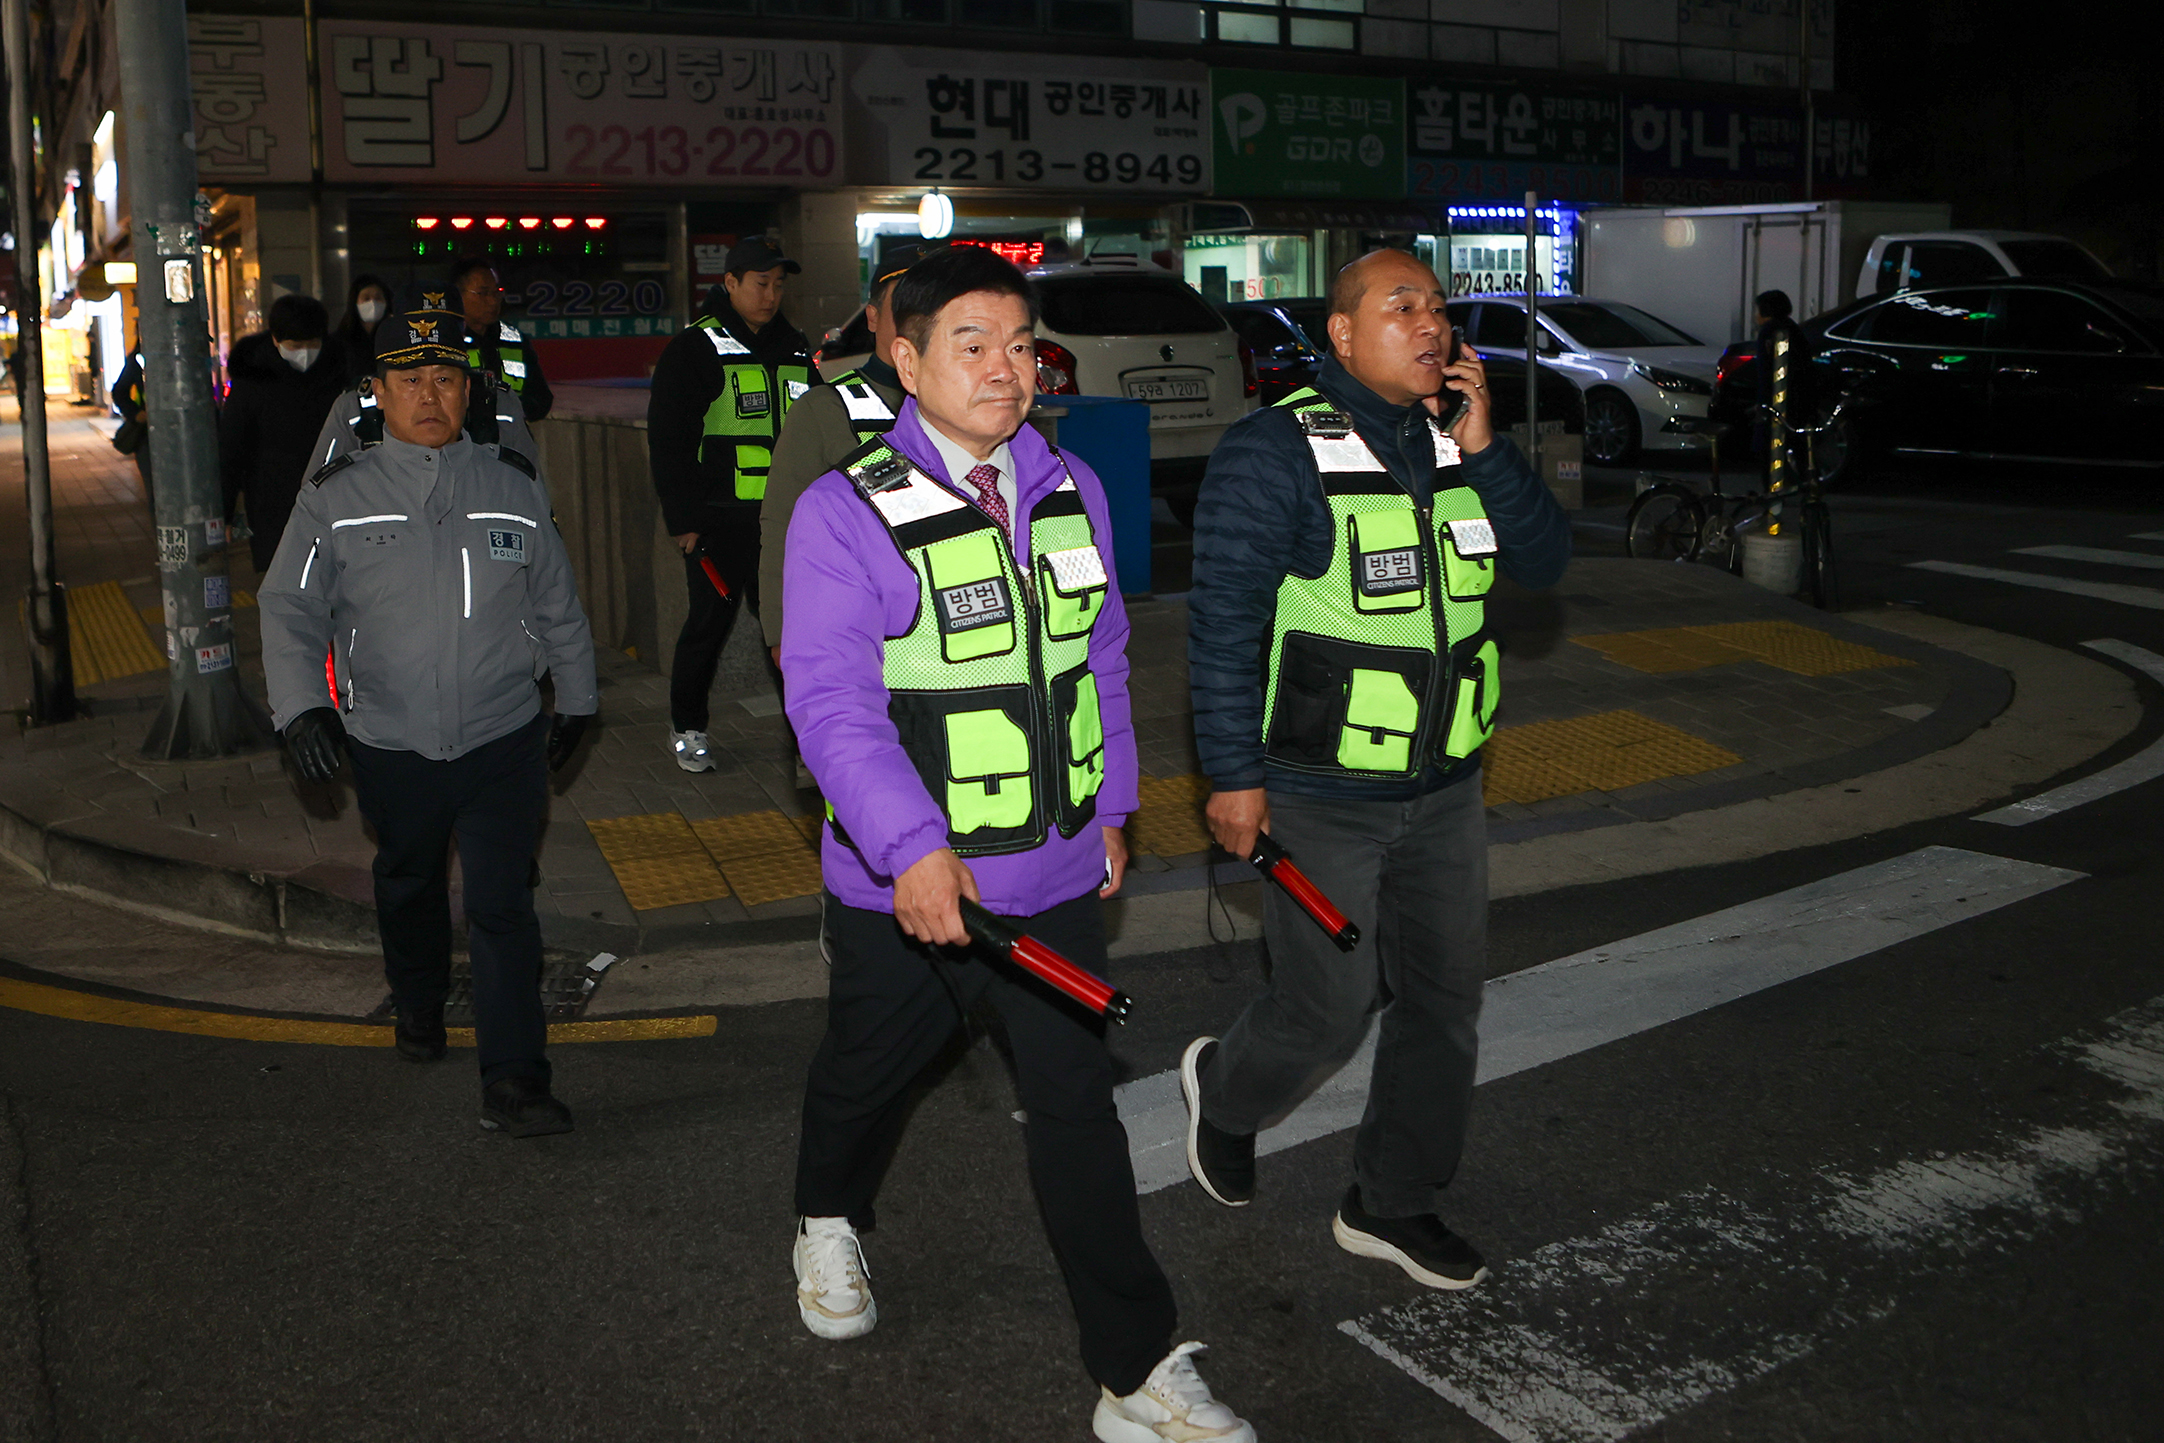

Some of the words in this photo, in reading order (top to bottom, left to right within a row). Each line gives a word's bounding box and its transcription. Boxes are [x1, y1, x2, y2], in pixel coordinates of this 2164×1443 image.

[331, 34, 549, 171] 딸기
[559, 43, 835, 104] 공인중개사
[926, 74, 1030, 141] 현대
[1044, 81, 1201, 119] 공인중개사
[1274, 93, 1394, 128] 골프존파크
[1415, 86, 1539, 155] 홈타운
[1286, 135, 1353, 163] GDR
[1629, 103, 1746, 171] 하나
[1815, 117, 1870, 179] 부동산
[914, 147, 1202, 185] 2213-8949
[1414, 162, 1617, 202] 2243-8500
[744, 392, 764, 406] 방범
[1170, 383, 1199, 397] 1207
[492, 532, 521, 550] 경찰
[493, 549, 523, 560] POLICE
[1370, 553, 1411, 578] 방범
[949, 582, 1000, 614] 방범
[1367, 580, 1394, 590] CITIZENS
[1394, 577, 1420, 587] PATROL
[950, 613, 982, 629] CITIZENS
[982, 609, 1008, 622] PATROL
